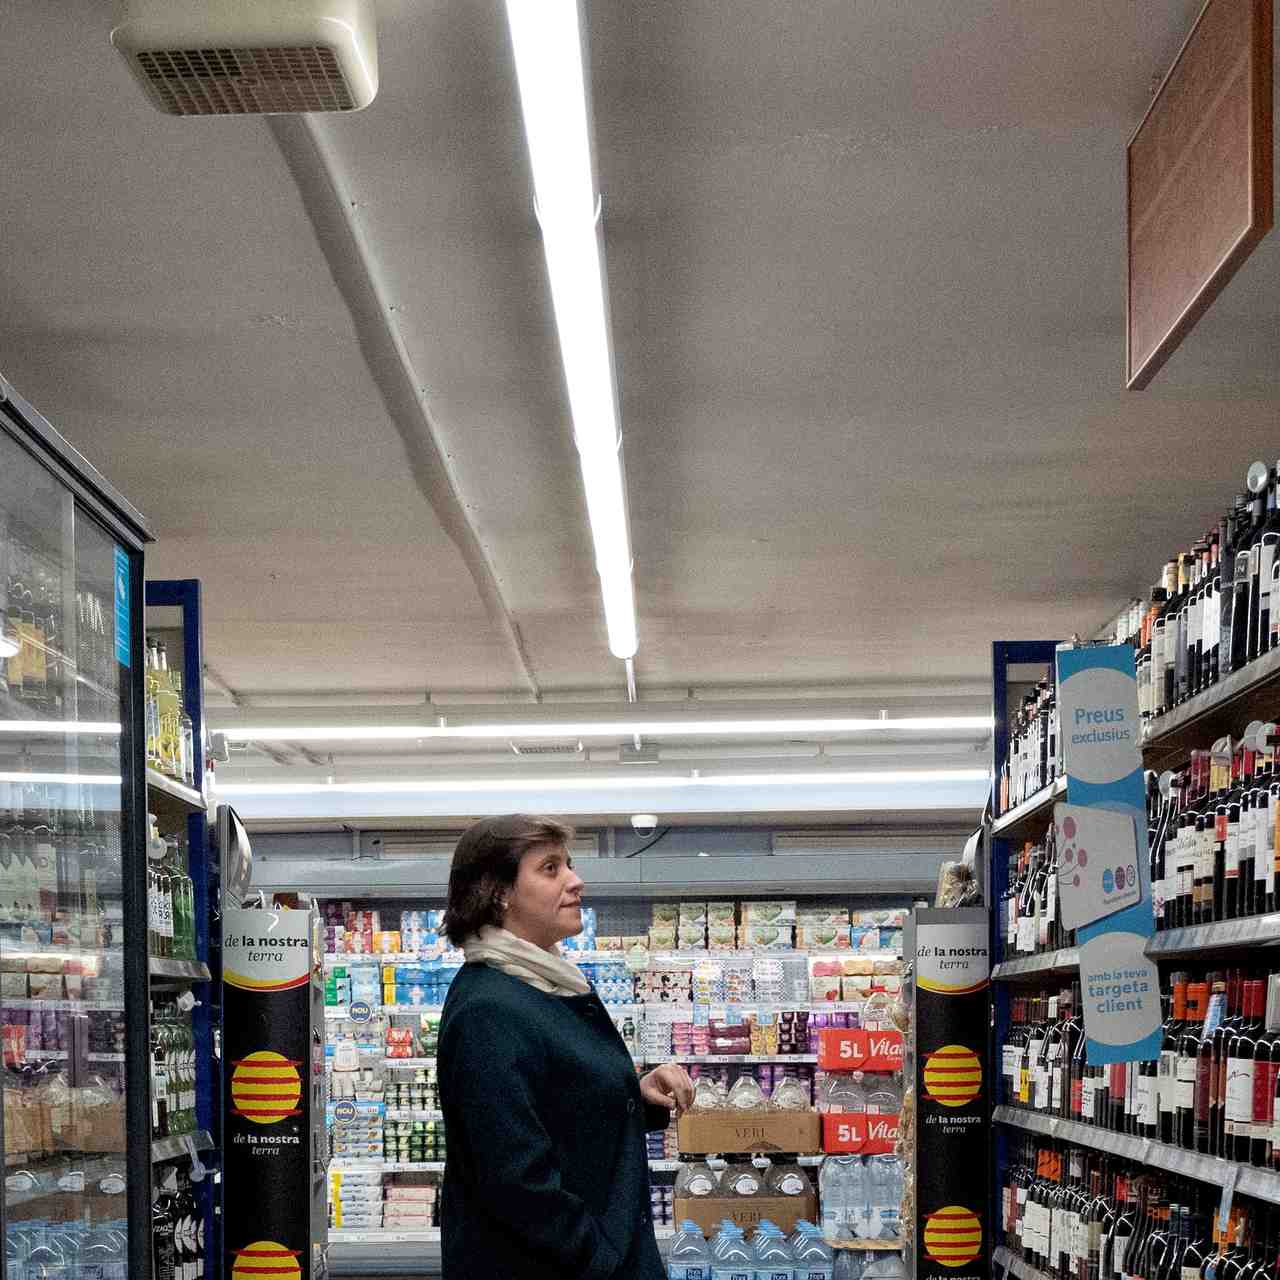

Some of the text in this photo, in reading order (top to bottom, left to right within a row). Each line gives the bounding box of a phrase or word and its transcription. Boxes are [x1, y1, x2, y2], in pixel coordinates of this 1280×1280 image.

[1074, 707, 1125, 724] Preus
[1071, 727, 1130, 744] exclusius
[224, 933, 309, 948] de la nostra
[247, 950, 283, 962] terra
[916, 945, 988, 958] de la nostra
[938, 959, 969, 970] terra
[1087, 972, 1109, 983] amb
[1124, 968, 1150, 979] teva
[1088, 981, 1149, 999] targeta
[351, 1006, 369, 1015] NOU
[1096, 998, 1143, 1014] client
[839, 1040, 864, 1059] 5L
[925, 1114, 981, 1125] de la nostra
[838, 1125, 862, 1142] 5L
[942, 1124, 966, 1134] terra
[233, 1133, 300, 1144] de la nostra
[251, 1145, 280, 1156] terra
